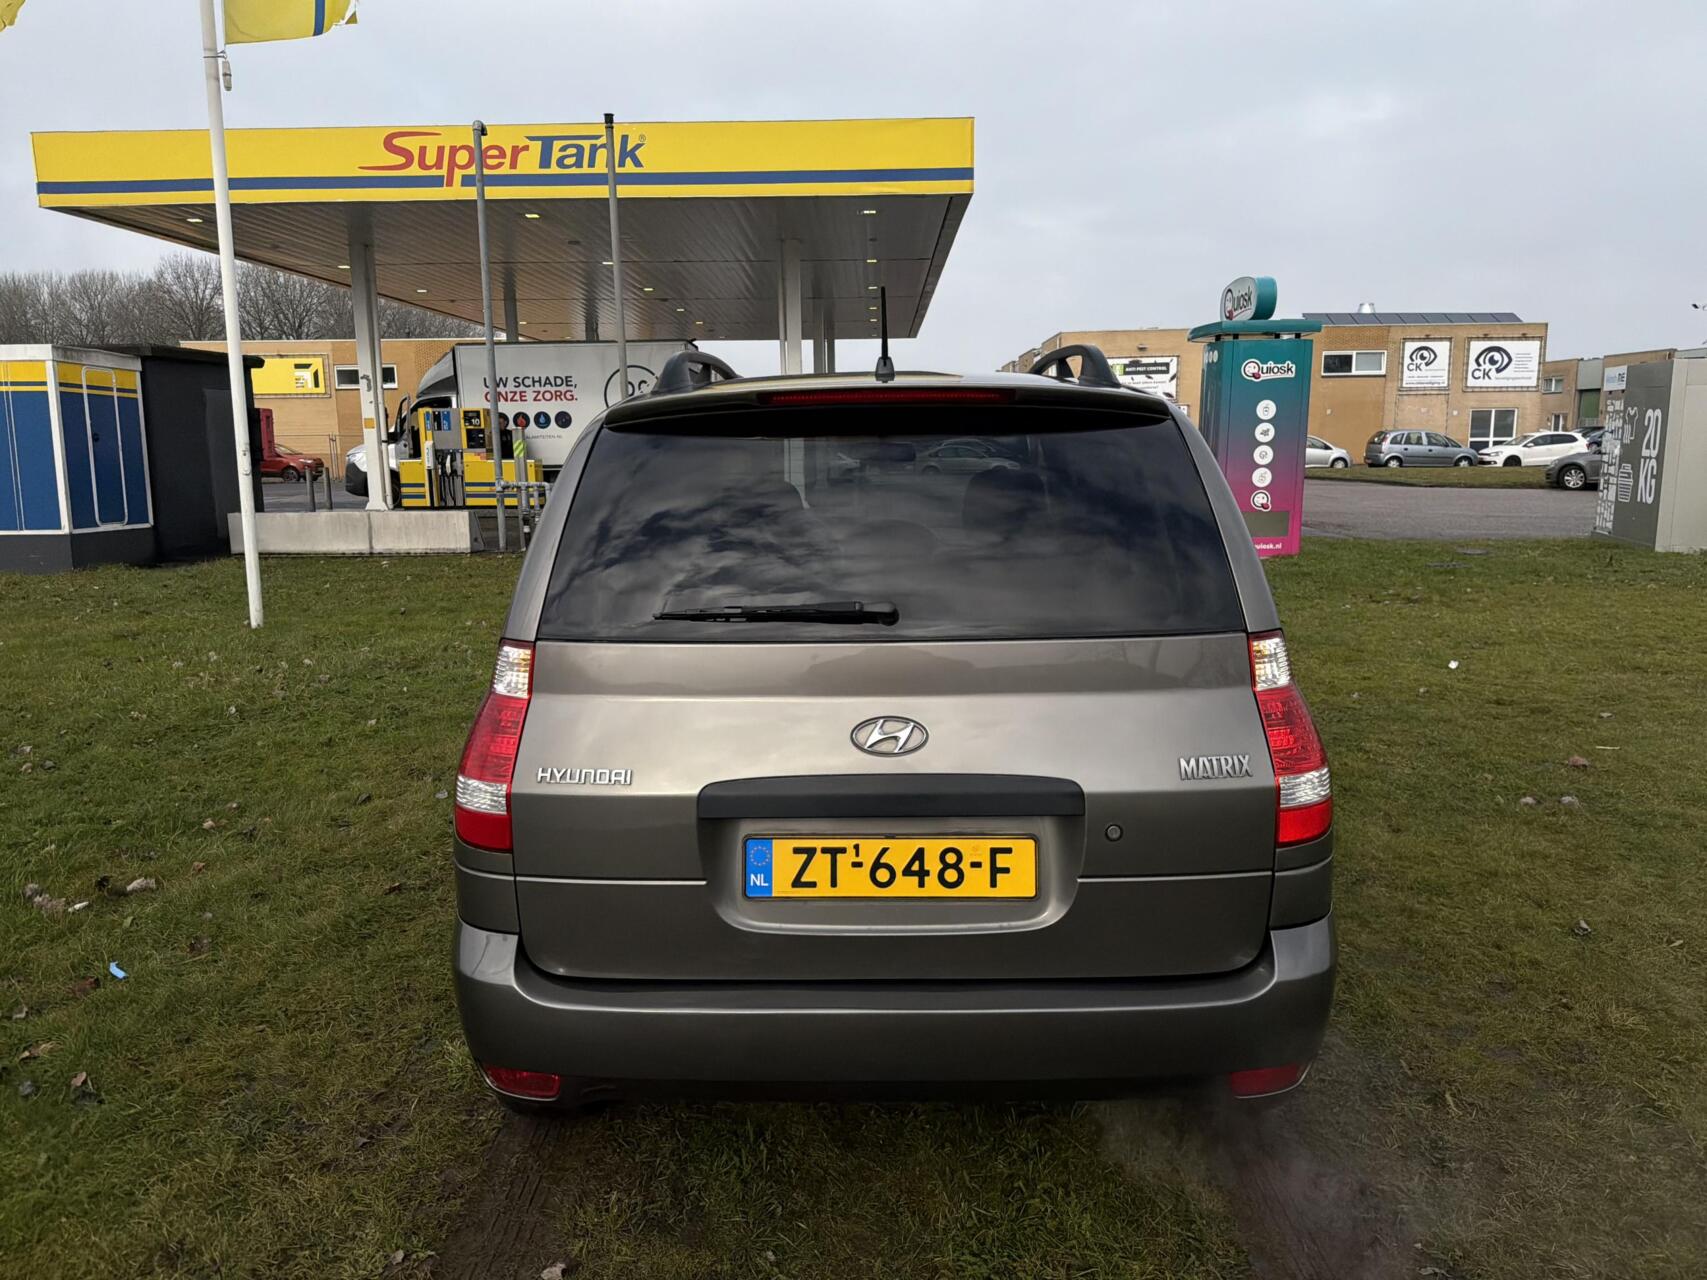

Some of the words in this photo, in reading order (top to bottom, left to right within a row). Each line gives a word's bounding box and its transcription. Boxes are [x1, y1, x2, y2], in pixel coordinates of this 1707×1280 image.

[1243, 360, 1294, 380] Quiosk
[1407, 362, 1423, 372] CK
[1471, 368, 1493, 380] CK
[513, 376, 578, 389] SCHADE,
[532, 389, 578, 402] ZORG.
[1642, 408, 1662, 457] 20
[1637, 458, 1657, 504] KG
[1179, 754, 1254, 780] MATRIX
[537, 767, 632, 785] HYUNDAI
[750, 873, 769, 887] NL
